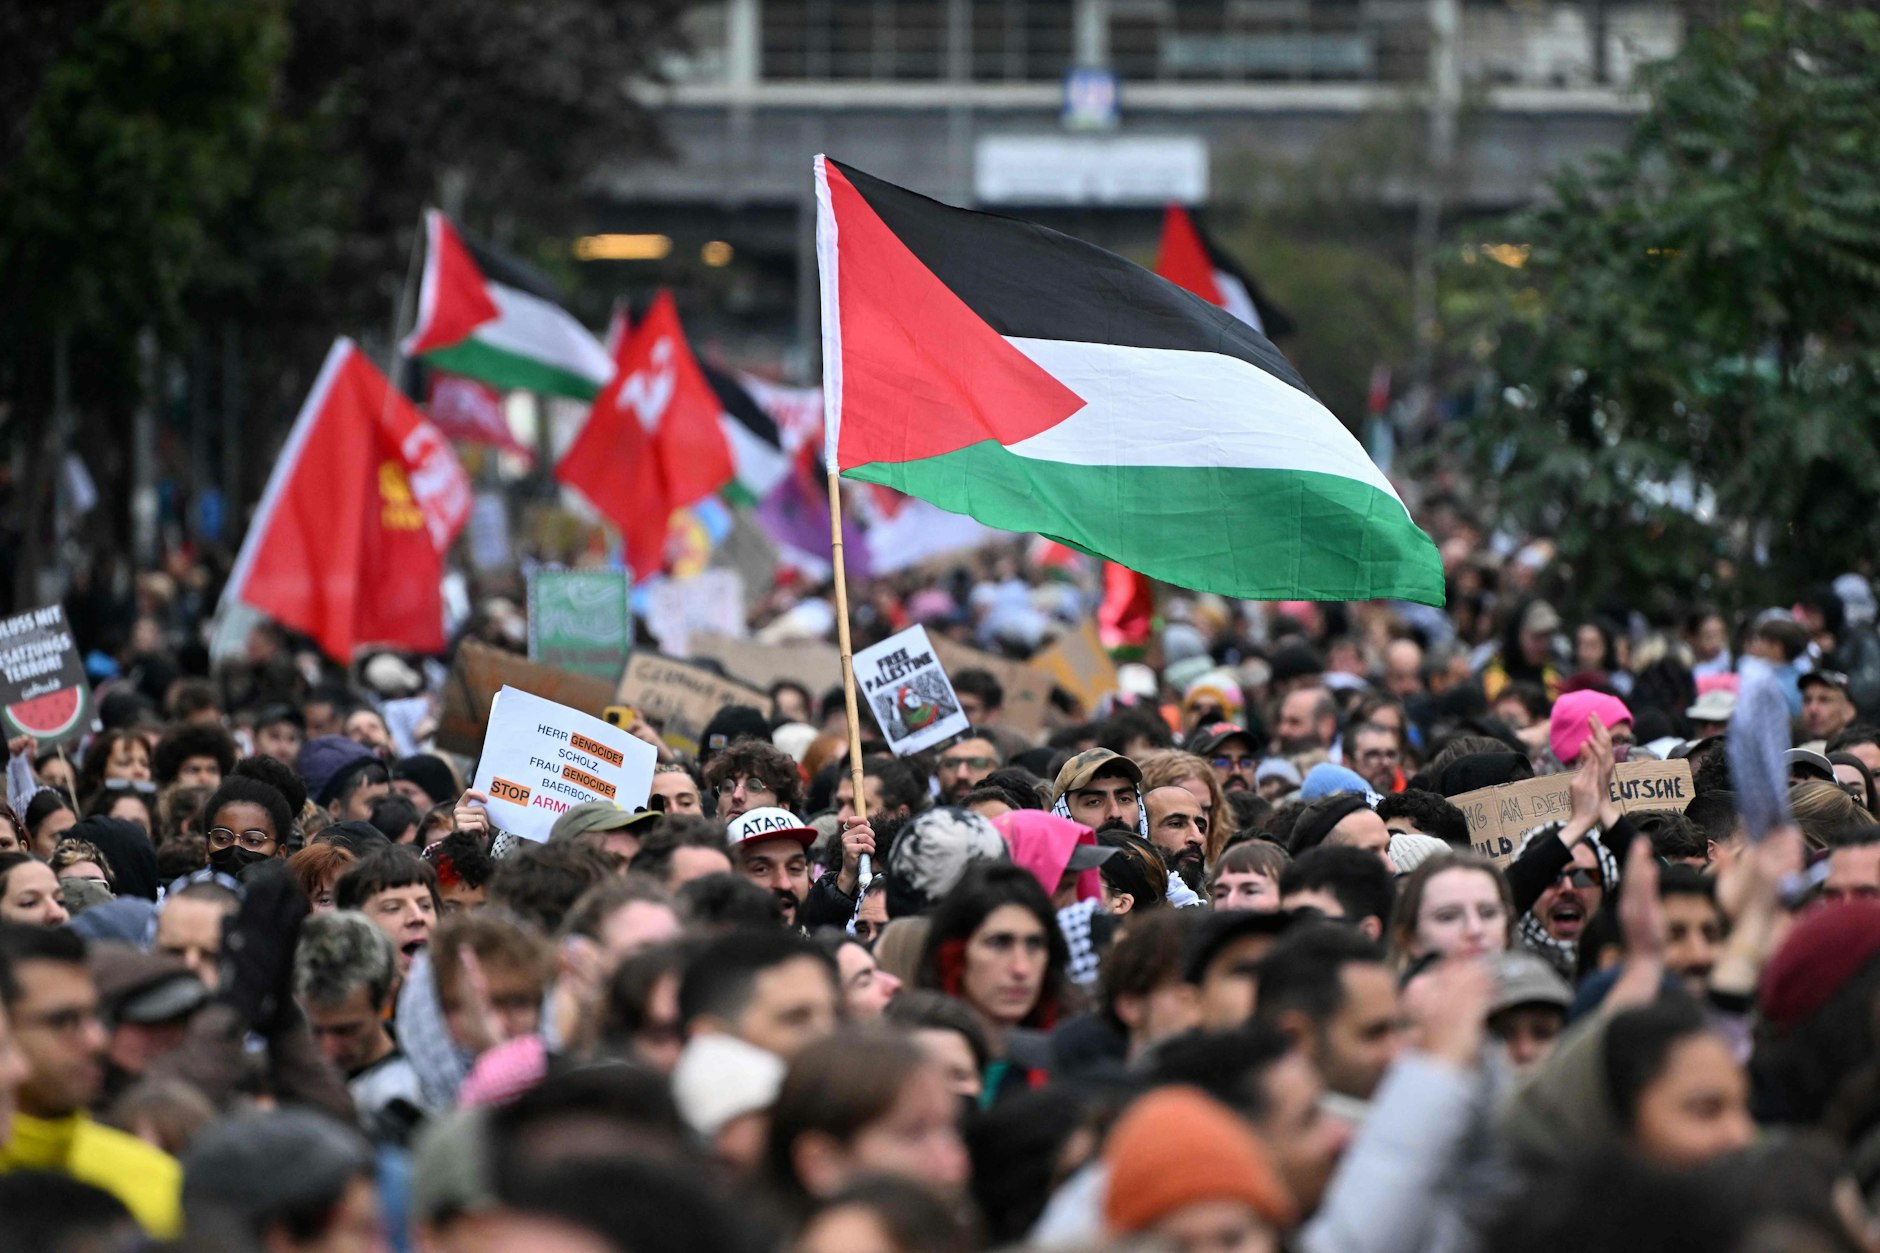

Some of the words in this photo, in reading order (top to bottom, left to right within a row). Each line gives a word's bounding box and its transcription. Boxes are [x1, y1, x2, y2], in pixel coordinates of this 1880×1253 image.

[877, 648, 909, 669] FREE
[865, 651, 933, 692] PALESTINE
[537, 723, 568, 741] HERR
[570, 735, 624, 765] GENOCIDE?
[558, 748, 599, 773] SCHOLZ,
[529, 757, 560, 773] FRAU
[562, 767, 616, 797] GENOCIDE?
[1608, 777, 1685, 802] EUTSCHE
[490, 780, 530, 801] STOP
[743, 816, 794, 838] ATARI
